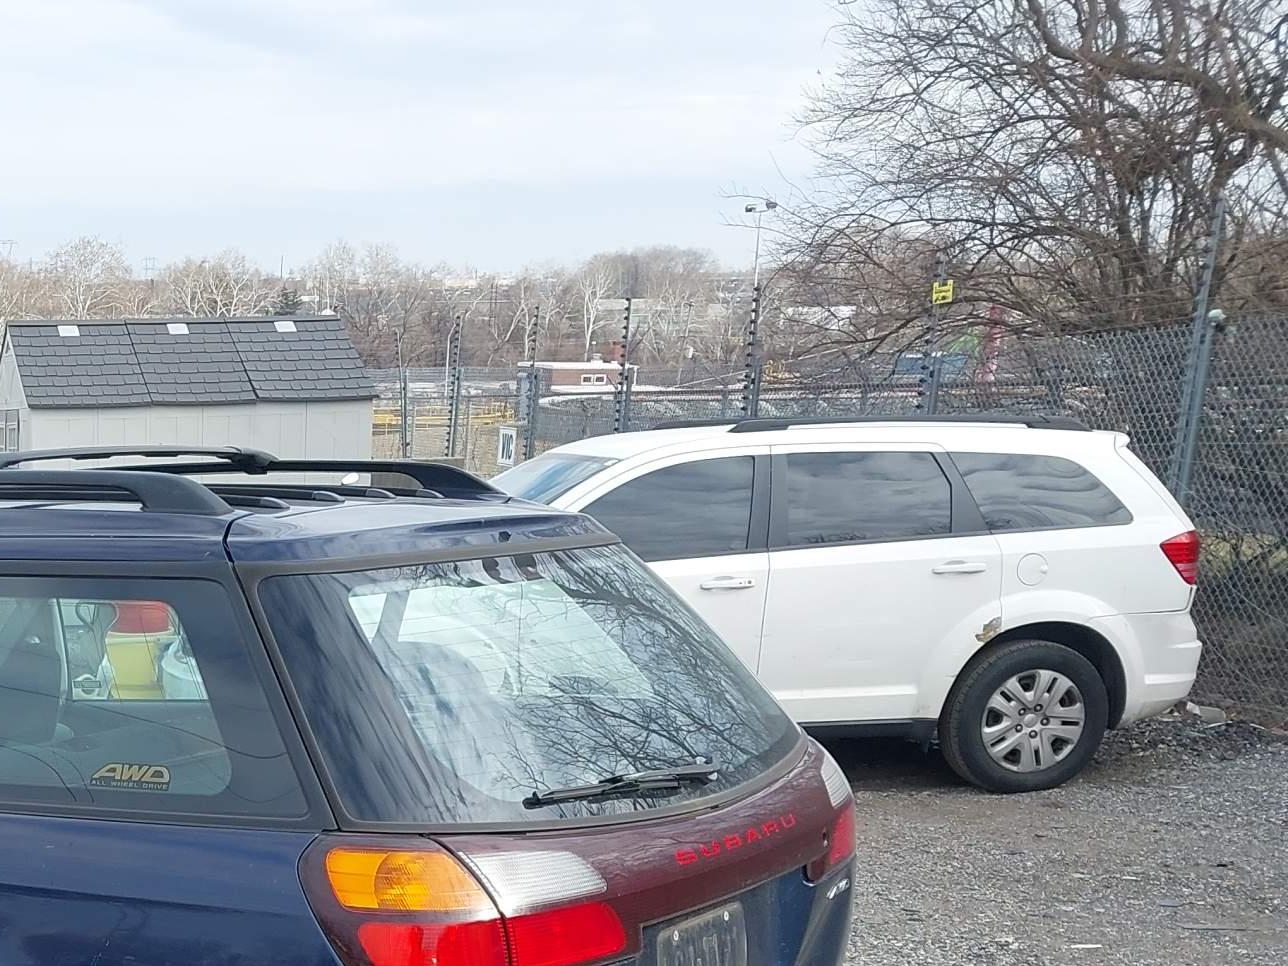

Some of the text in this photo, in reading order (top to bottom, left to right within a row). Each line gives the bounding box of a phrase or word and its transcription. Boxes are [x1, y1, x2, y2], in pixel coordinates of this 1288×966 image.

[92, 763, 170, 783] AWD
[110, 780, 140, 789] WHEEL
[142, 783, 169, 791] DRIVE
[675, 814, 796, 865] SUBARU
